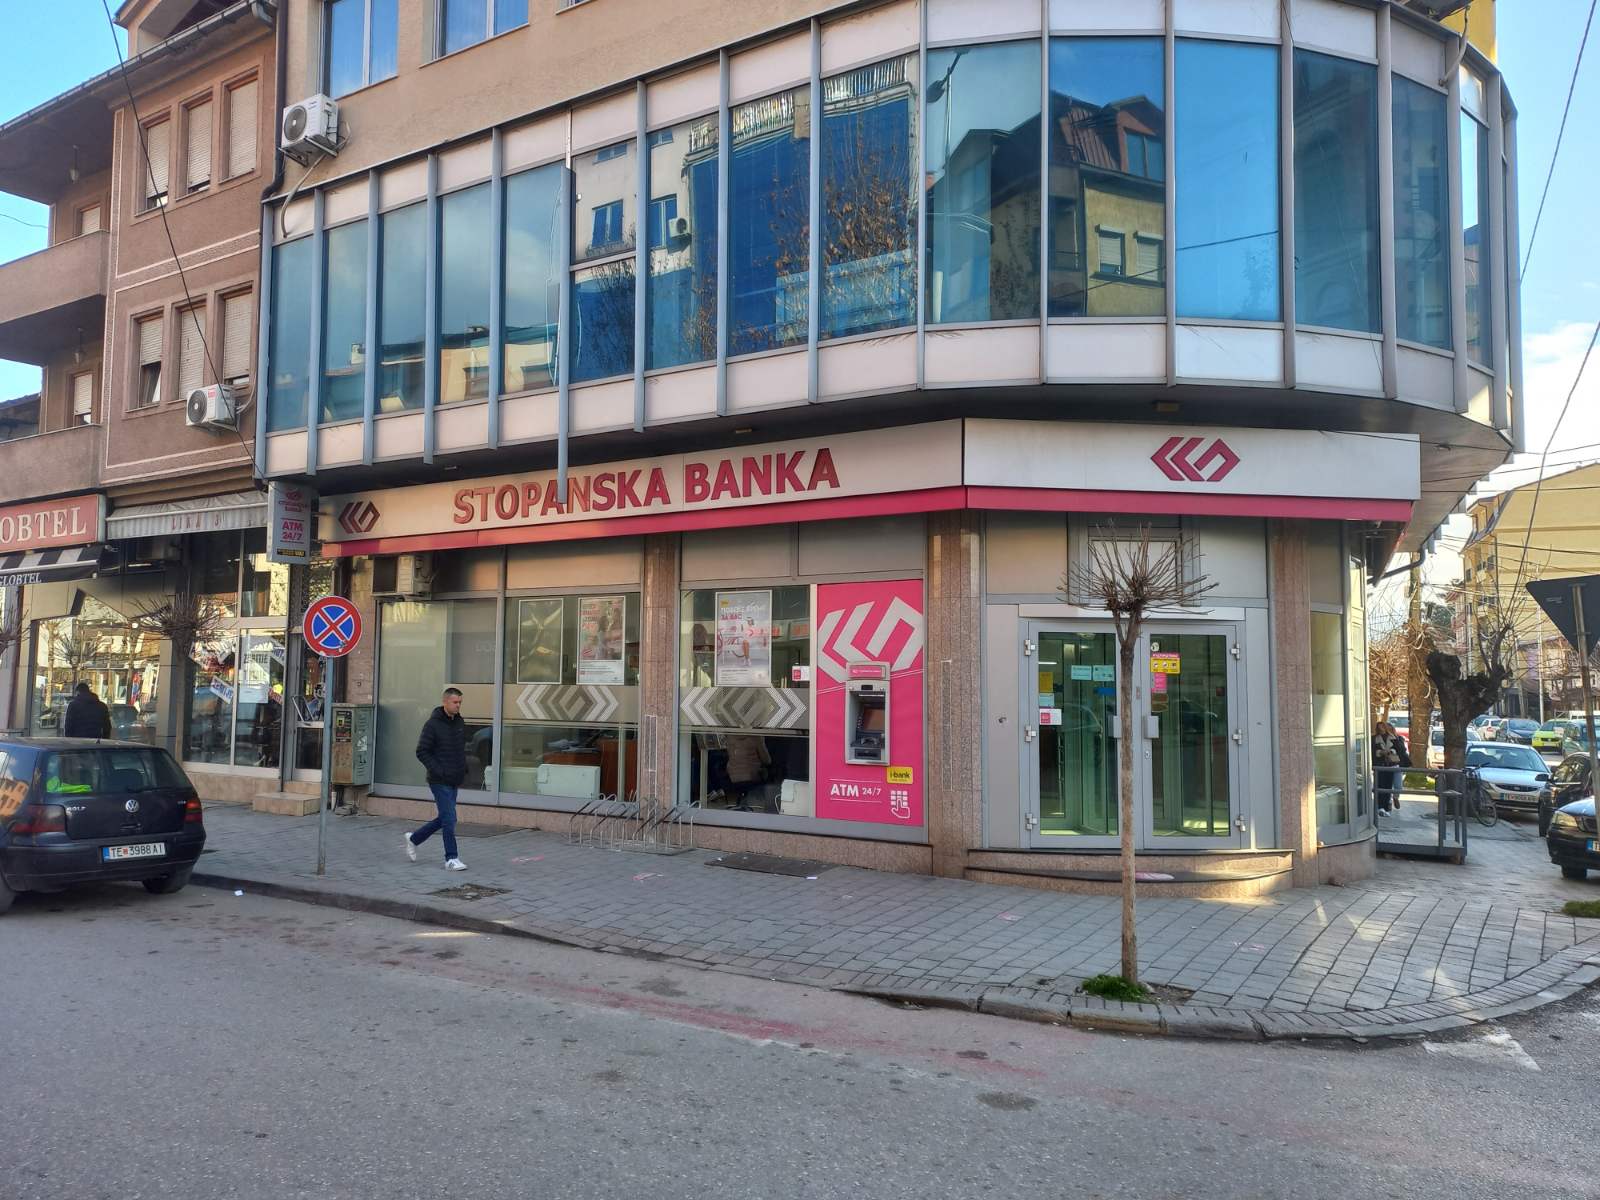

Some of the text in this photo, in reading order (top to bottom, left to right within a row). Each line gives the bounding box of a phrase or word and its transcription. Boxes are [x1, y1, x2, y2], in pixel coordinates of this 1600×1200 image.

[452, 447, 841, 525] STOPANSKA BANKA
[282, 520, 303, 532] ATM
[282, 532, 303, 541] 24/7
[830, 783, 882, 797] ATM 24/7
[110, 847, 123, 859] TE
